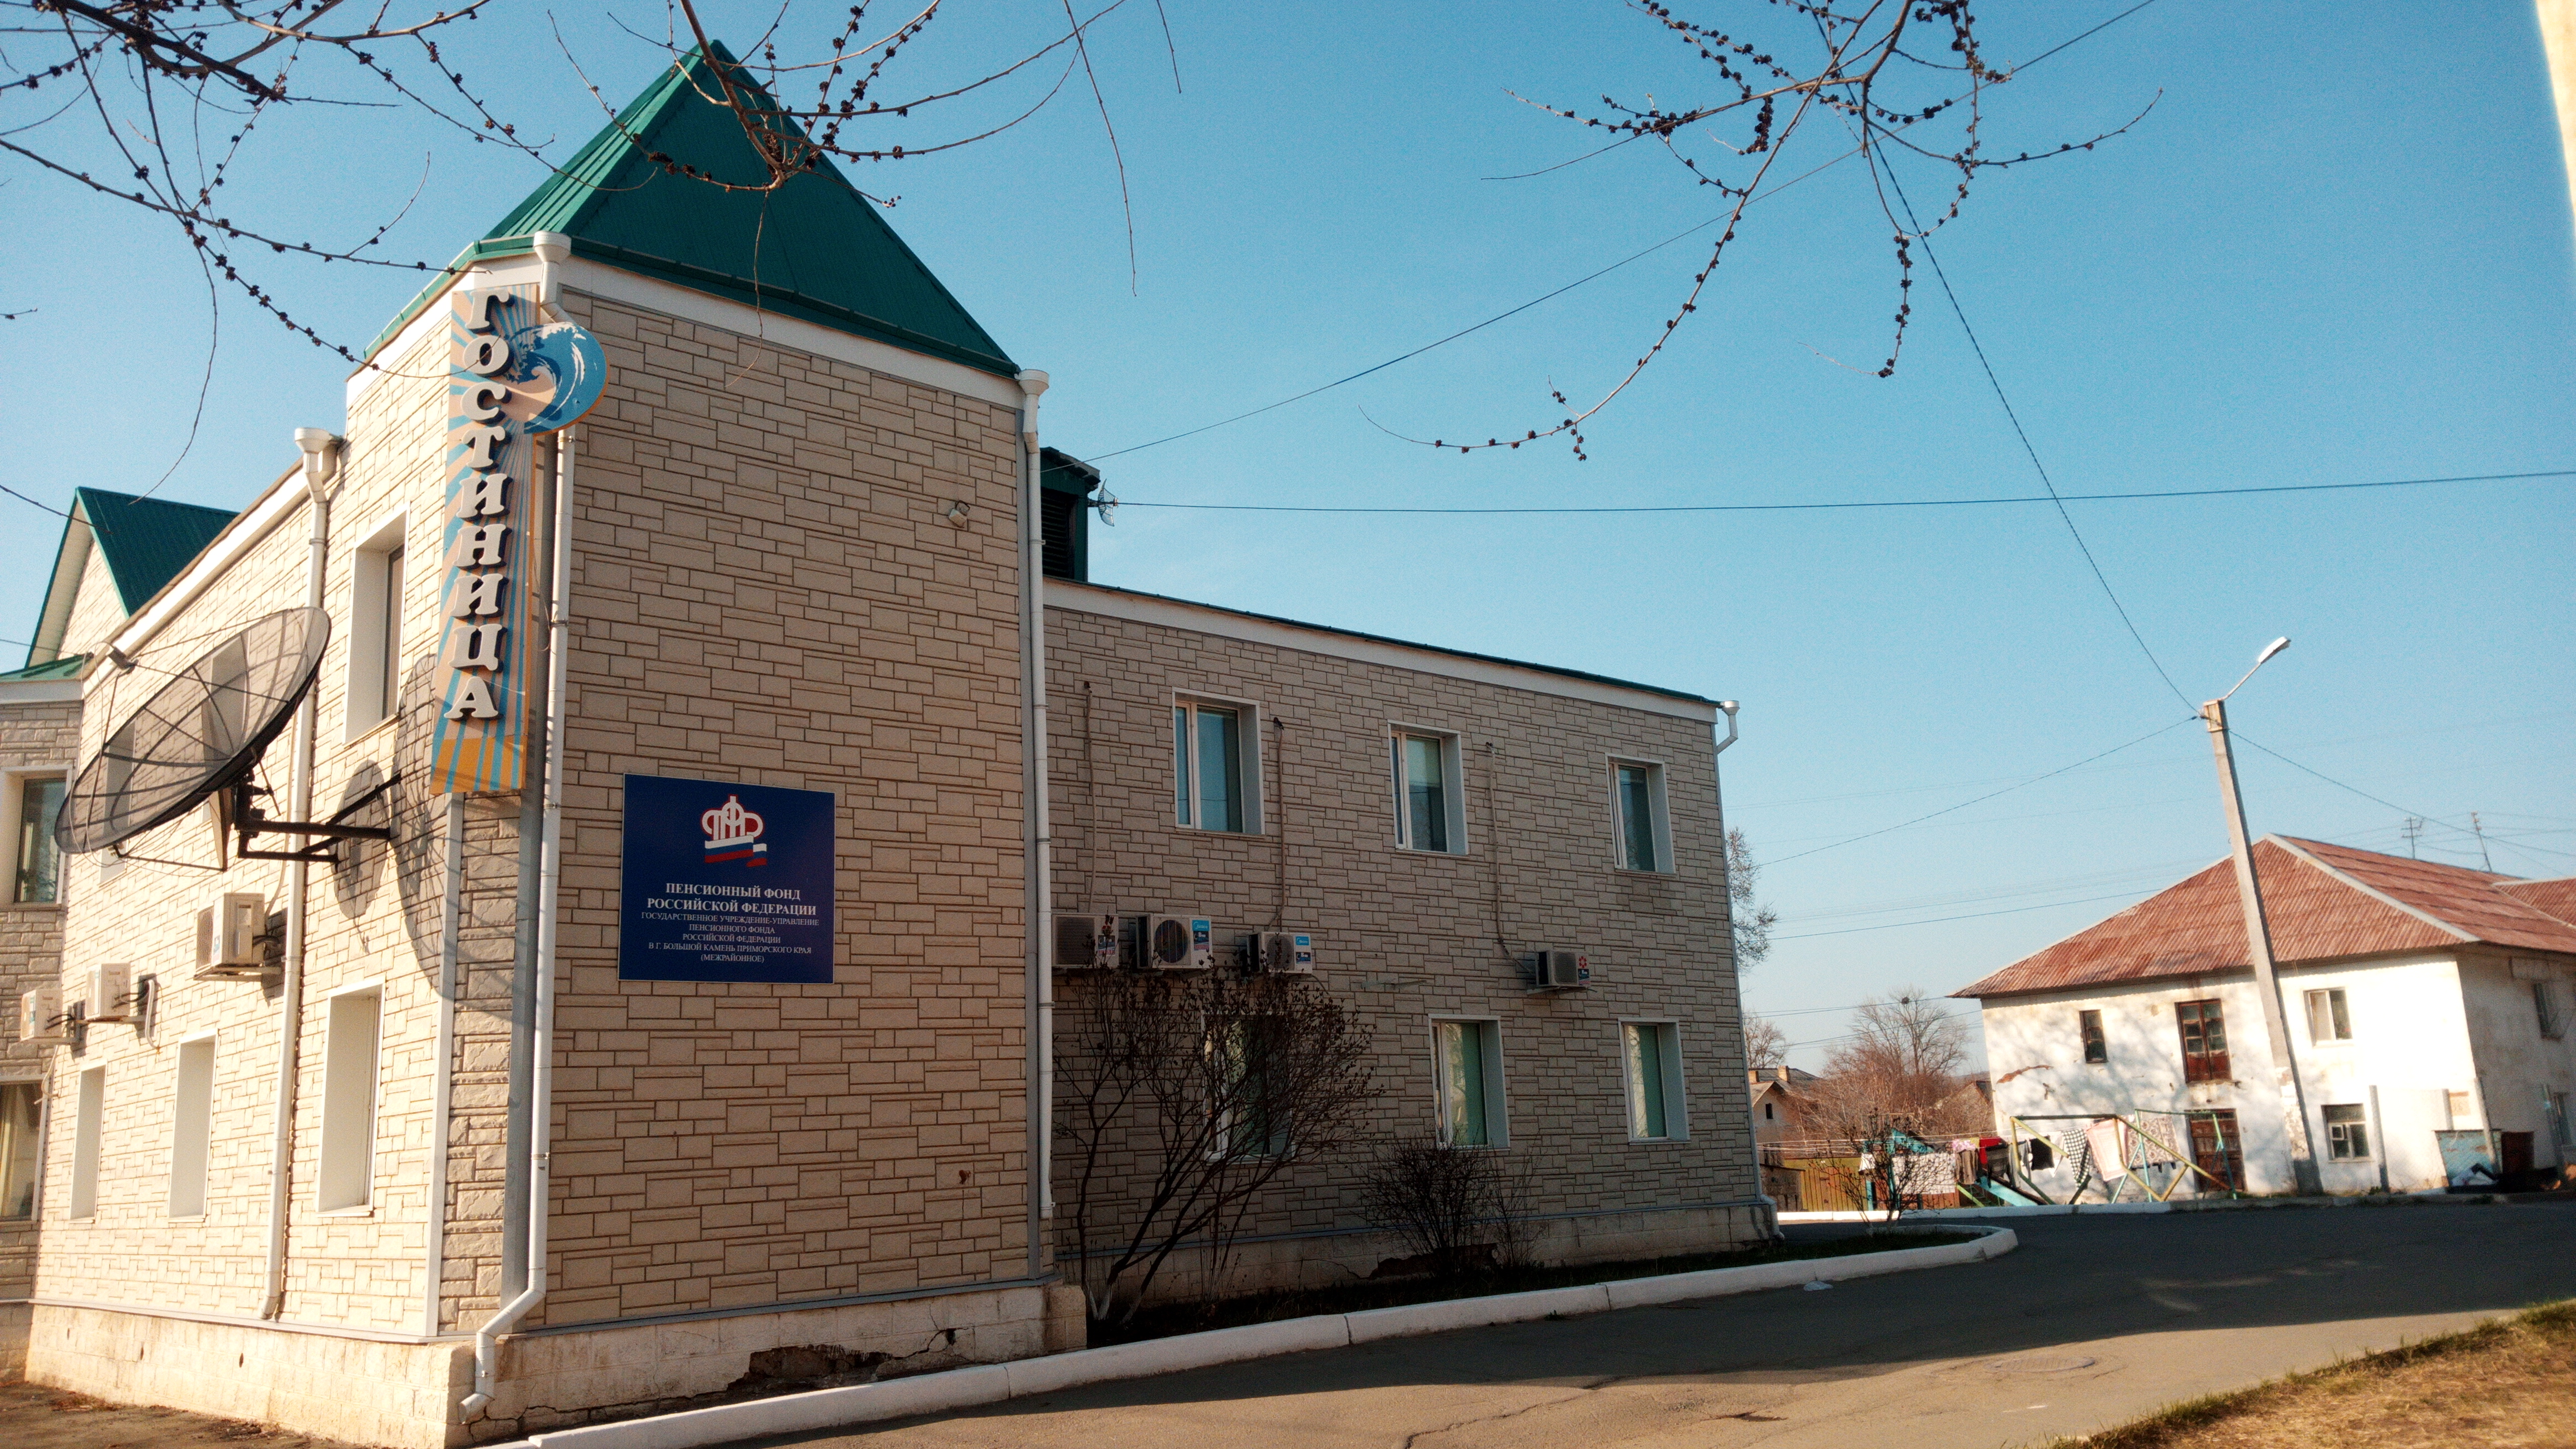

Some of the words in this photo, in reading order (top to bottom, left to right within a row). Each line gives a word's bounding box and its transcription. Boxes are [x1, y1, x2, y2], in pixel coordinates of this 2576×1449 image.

[444, 289, 510, 720] ГОСТИНИЦА
[665, 882, 761, 898] ПЕНСИОННЫЙ
[764, 888, 801, 902] ФОНД
[647, 898, 739, 912] РОССИЙСКОЙ
[741, 903, 817, 916] ФЕДЕРАЦИИ
[641, 912, 718, 922] ГОСУДАРСТВЕННОЕ
[719, 915, 820, 926] УЧРЕЖДЕНИЕ-УПРАВЛЕНИЕ
[689, 924, 747, 932] ПЕНСИОННОГО
[682, 933, 735, 942] РОССИЙСКОЙ
[736, 935, 781, 944] ФЕДЕРАЦИИ
[663, 942, 702, 950] БОЛЬШОЙ
[703, 944, 736, 952] КАМЕНЬ
[737, 945, 792, 953] ПРИМОРСКОГО
[700, 953, 765, 963] (МЕЖРАЙОННОЕ)
